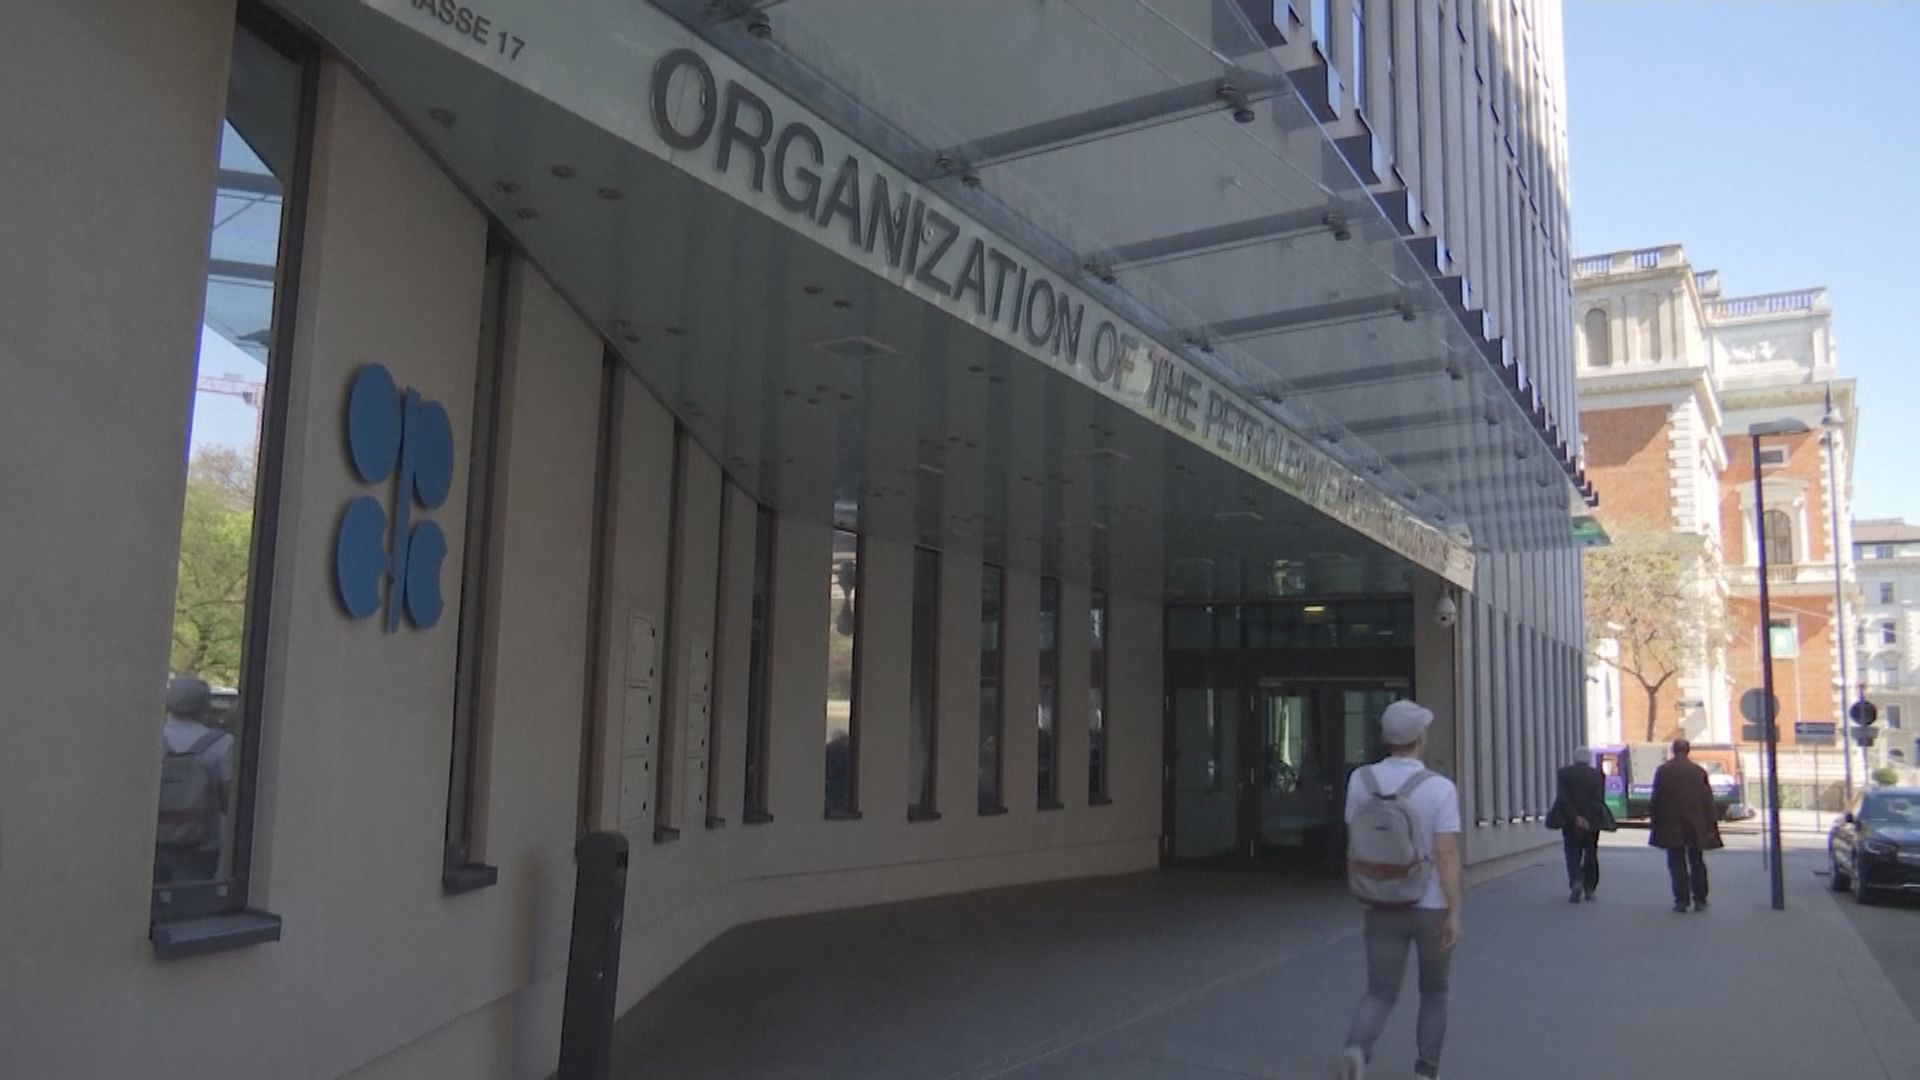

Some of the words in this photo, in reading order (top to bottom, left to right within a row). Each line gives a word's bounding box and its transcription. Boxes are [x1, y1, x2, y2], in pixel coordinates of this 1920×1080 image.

[411, 0, 491, 45] ASSE
[498, 31, 526, 61] 17
[650, 48, 1084, 365] ORGANIZATION
[1090, 320, 1140, 391] OF
[1147, 350, 1202, 431] THE
